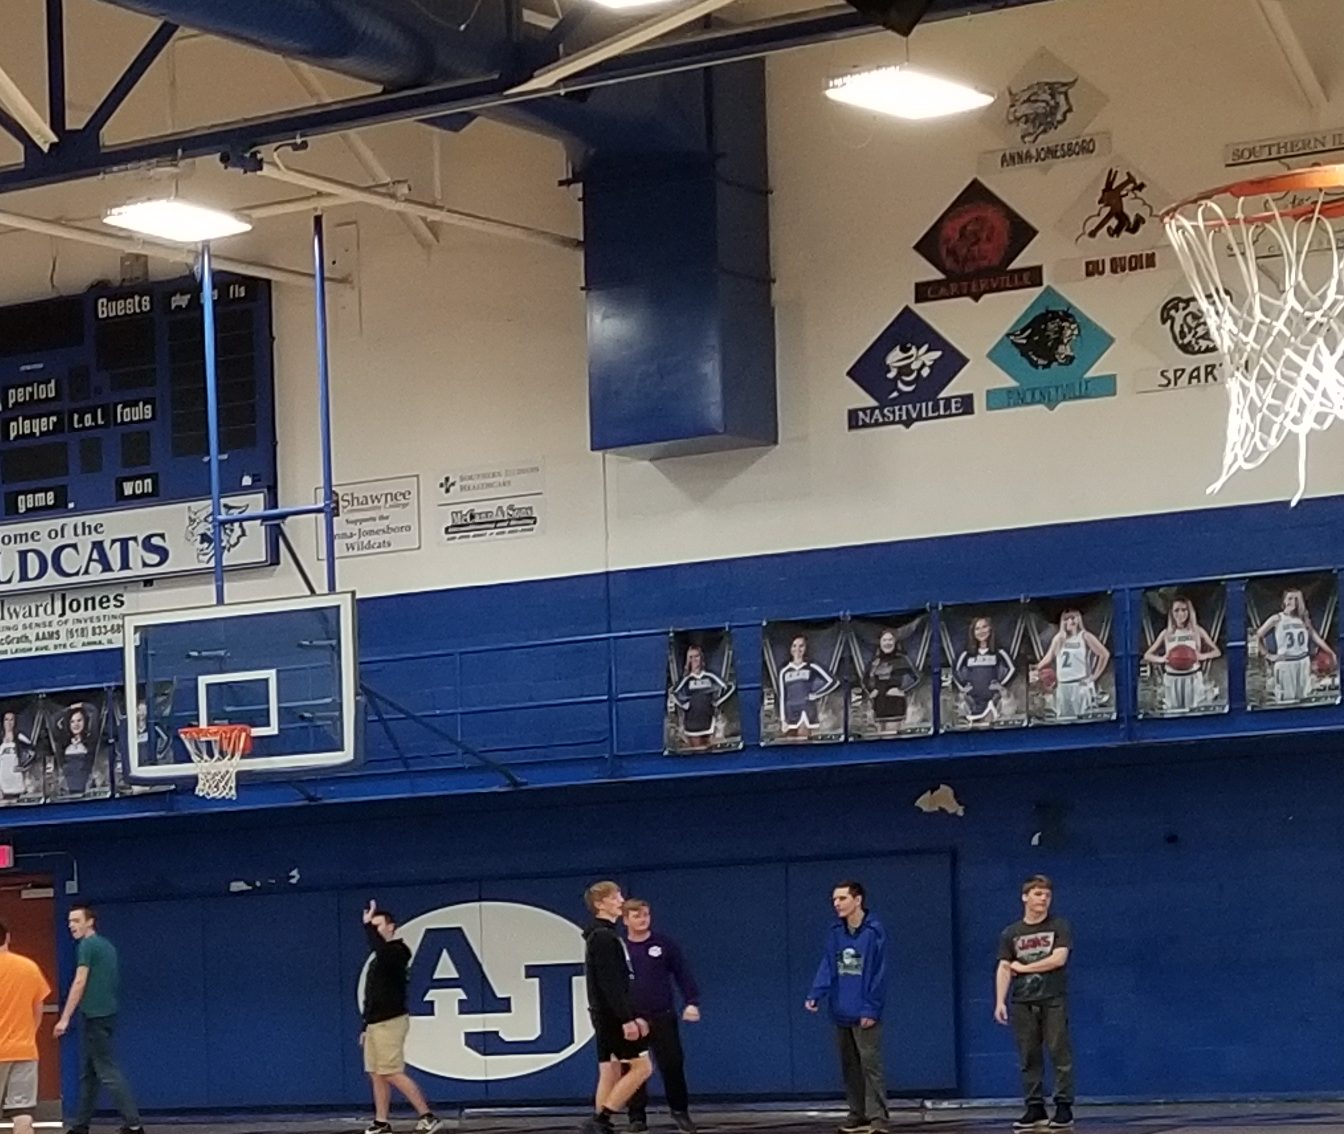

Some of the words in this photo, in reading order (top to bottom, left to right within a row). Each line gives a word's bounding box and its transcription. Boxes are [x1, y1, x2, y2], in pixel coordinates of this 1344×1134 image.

[1000, 138, 1096, 169] ANNA-JONESBORO
[1231, 132, 1326, 162] SOUTHERN
[1084, 259, 1105, 278] DU
[97, 293, 151, 319] Guests
[1157, 361, 1224, 389] SPAR
[7, 378, 57, 408] period
[8, 412, 58, 440] player
[116, 401, 153, 425] fouls
[856, 397, 964, 426] NASHVILLE
[17, 490, 55, 513] game
[123, 478, 153, 497] won
[340, 489, 412, 509] Shawnee
[48, 524, 67, 543] of
[72, 519, 106, 540] the
[334, 524, 412, 540] nna-Jonesboro
[345, 539, 392, 552] Wildcats
[57, 591, 126, 618] Jones
[21, 620, 54, 631] SENSE
[56, 618, 71, 627] OF
[1285, 630, 1306, 649] 30
